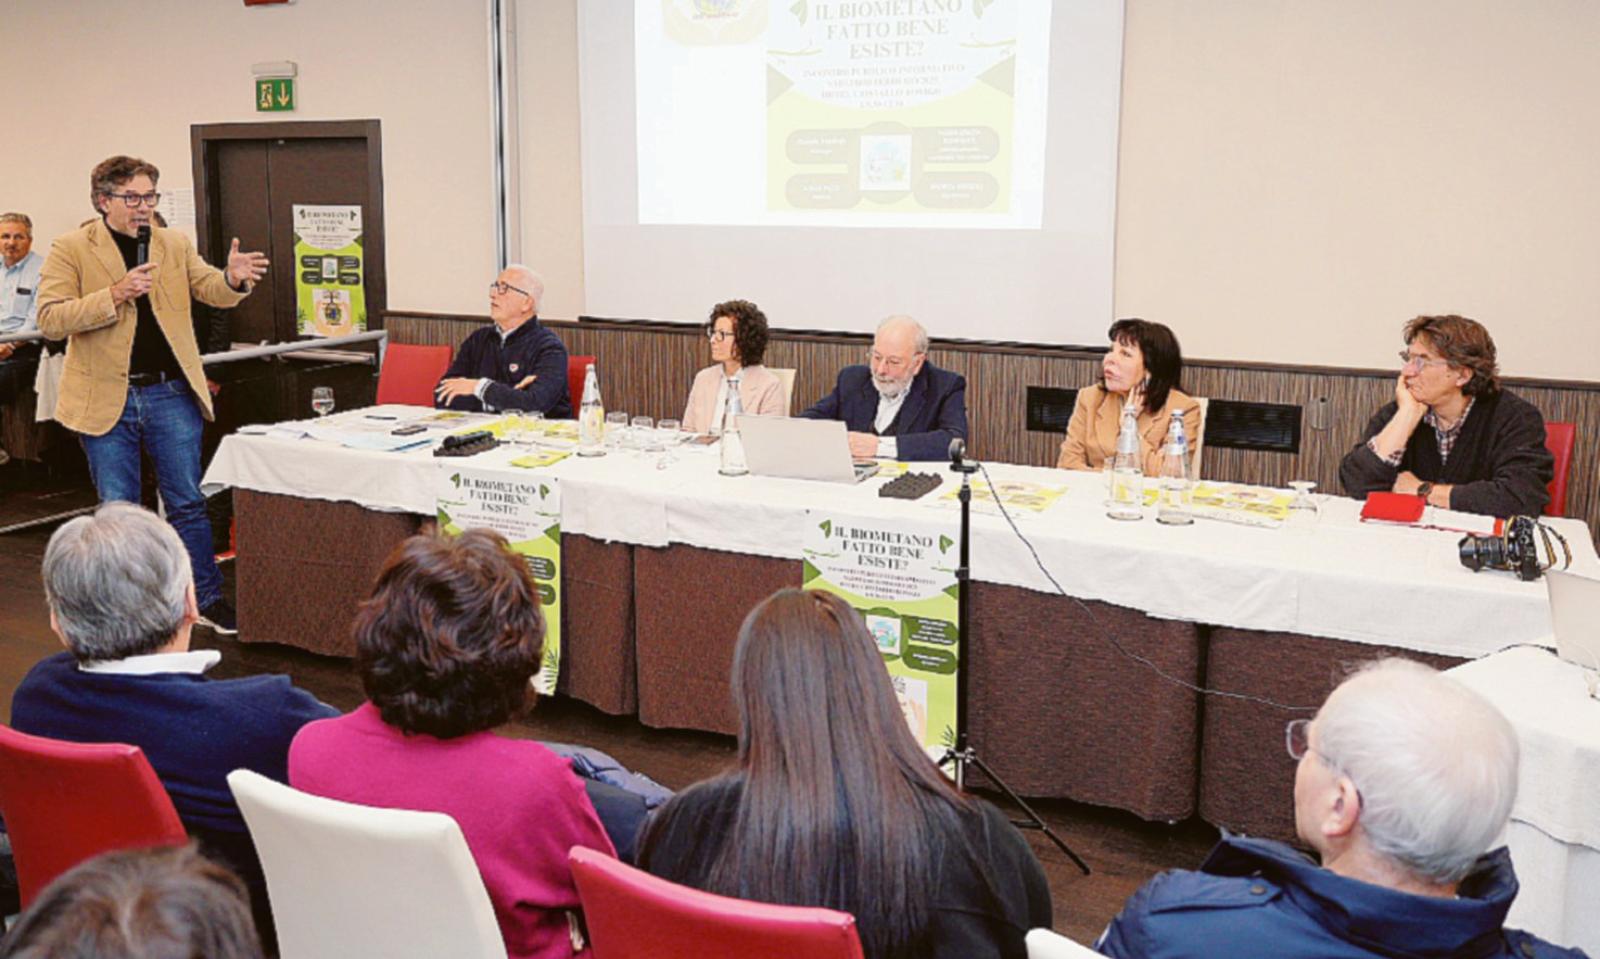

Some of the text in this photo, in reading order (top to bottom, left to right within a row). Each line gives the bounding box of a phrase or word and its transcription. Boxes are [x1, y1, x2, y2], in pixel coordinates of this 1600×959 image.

[815, 0, 962, 20] IL BIOMETANO
[827, 18, 949, 40] FATTO BENE
[850, 40, 925, 60] ESISTE?
[834, 525, 933, 548] IL BIOMETANO
[842, 540, 925, 559] FATTO BENE
[858, 554, 910, 571] ESISTE?
